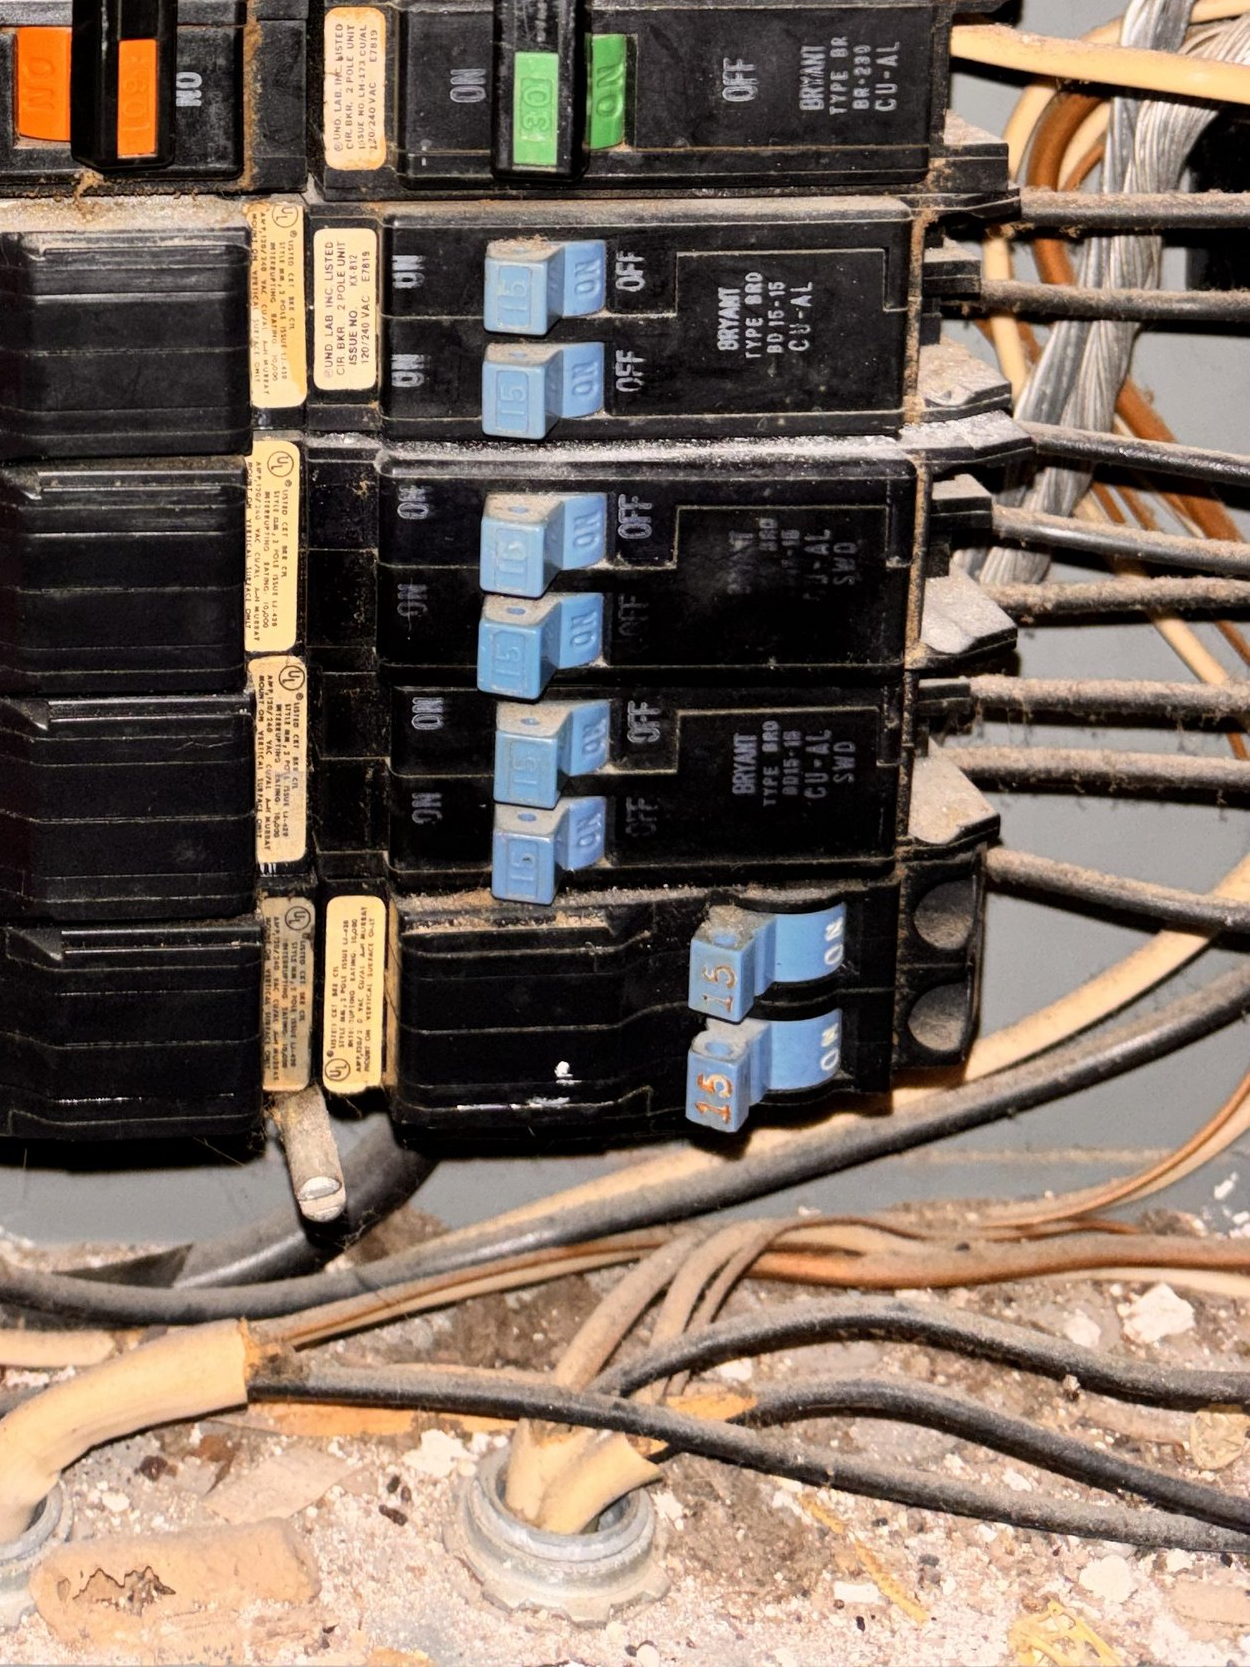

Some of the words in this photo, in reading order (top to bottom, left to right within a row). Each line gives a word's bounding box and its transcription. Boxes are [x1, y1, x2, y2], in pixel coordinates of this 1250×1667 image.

[347, 24, 355, 49] UNIT
[369, 30, 377, 62] E7819
[830, 36, 849, 57] BR
[449, 68, 487, 103] ON
[595, 62, 624, 118] ON
[721, 57, 759, 102] OFF
[799, 45, 826, 110] BRYANT
[829, 70, 849, 115] TYPE
[852, 44, 871, 109] BR-230
[875, 42, 900, 112] CU-AL
[521, 87, 551, 132] 30
[368, 107, 377, 150] 120/240
[324, 241, 334, 281] LISTED
[337, 241, 345, 267] UNIT
[349, 254, 358, 287] KX-812
[361, 251, 370, 282] E7819
[391, 254, 426, 289] ON
[615, 250, 646, 292] OFF
[337, 271, 346, 300] POLE
[499, 280, 527, 311] 15
[574, 259, 600, 295] ON
[745, 272, 763, 305] BRD
[361, 295, 370, 318] VAC
[717, 287, 740, 351] BRYANT
[348, 331, 358, 365] ISSUE
[361, 322, 370, 364] 120/240
[745, 317, 763, 358] TYPE
[390, 353, 425, 388] ON
[571, 359, 599, 396] ON
[615, 349, 646, 392] OFF
[499, 385, 527, 415] 15
[396, 484, 430, 519] ON
[617, 493, 652, 539] OFF
[572, 510, 600, 548] ON
[570, 610, 597, 647] ON
[496, 646, 522, 676] 15
[411, 697, 445, 731] ON
[627, 700, 660, 743] OFF
[582, 718, 607, 755] ON
[761, 720, 780, 752] BRD
[513, 756, 538, 785] 15
[731, 732, 757, 794] BRYANT
[803, 729, 832, 798] CU-AL
[832, 741, 856, 783] SWD
[762, 766, 780, 806] TYPE
[576, 813, 602, 847] ON
[510, 851, 534, 881] 15
[824, 917, 844, 965] ON
[702, 965, 737, 1013] 15
[820, 1023, 839, 1071] ON
[694, 1072, 734, 1125] 15
